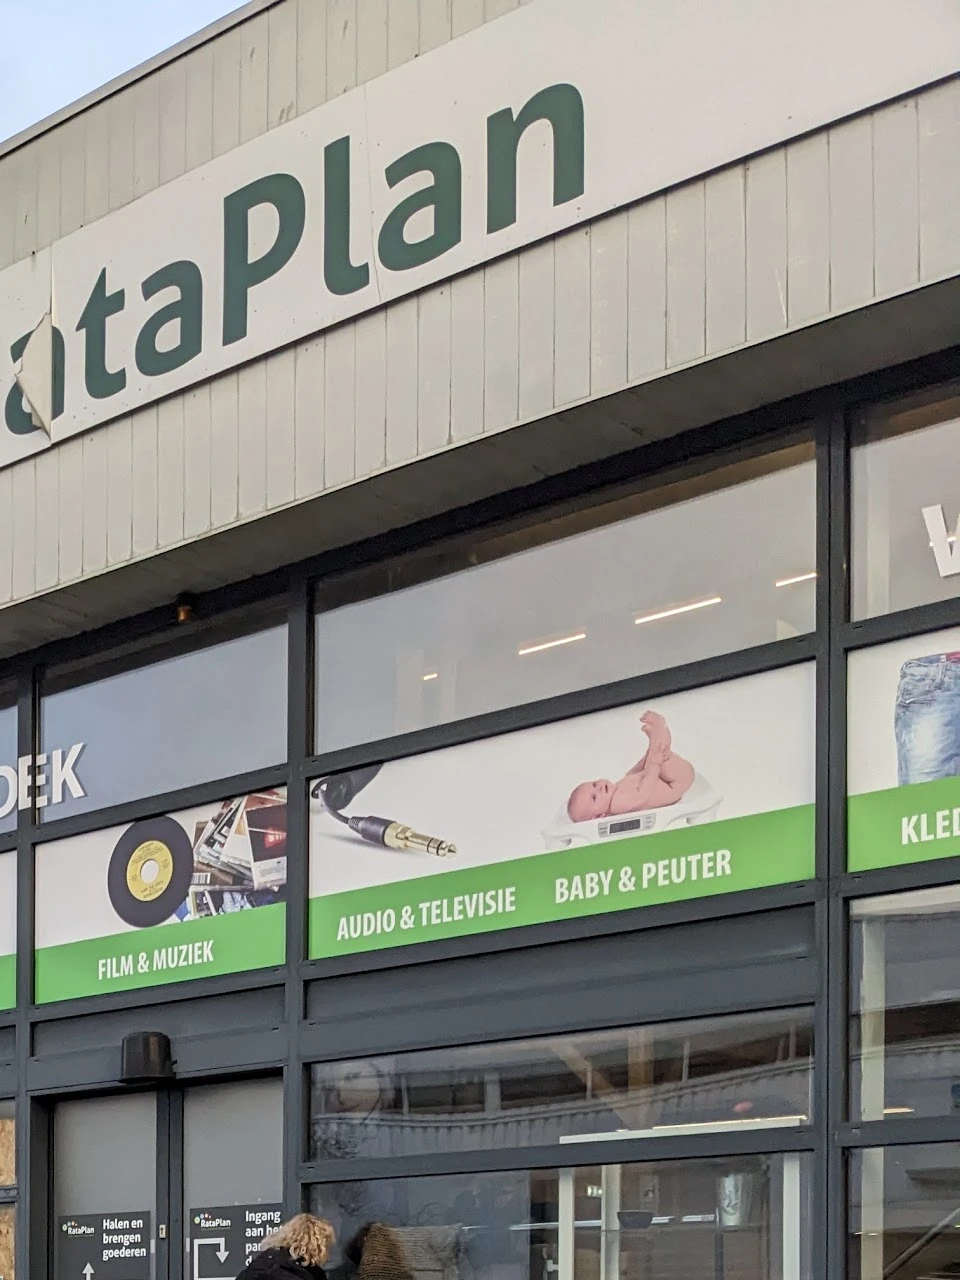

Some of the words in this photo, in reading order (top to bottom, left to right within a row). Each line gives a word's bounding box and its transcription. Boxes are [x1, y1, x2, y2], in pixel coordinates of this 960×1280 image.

[555, 868, 614, 903] BABY
[618, 867, 636, 892] &
[642, 849, 731, 889] PEUTER
[337, 909, 395, 941] AUDIO
[400, 908, 414, 930] &
[419, 886, 516, 926] TELEVISIE
[98, 955, 133, 980] FILM
[137, 951, 149, 973] &
[153, 940, 214, 971] MUZIEK
[103, 1218, 129, 1230] Halen
[131, 1219, 143, 1229] en
[201, 1218, 231, 1228] RataPlan
[245, 1210, 281, 1224] Ingang
[103, 1233, 141, 1246] brengen
[245, 1228, 263, 1237] aan
[103, 1246, 146, 1261] goederen
